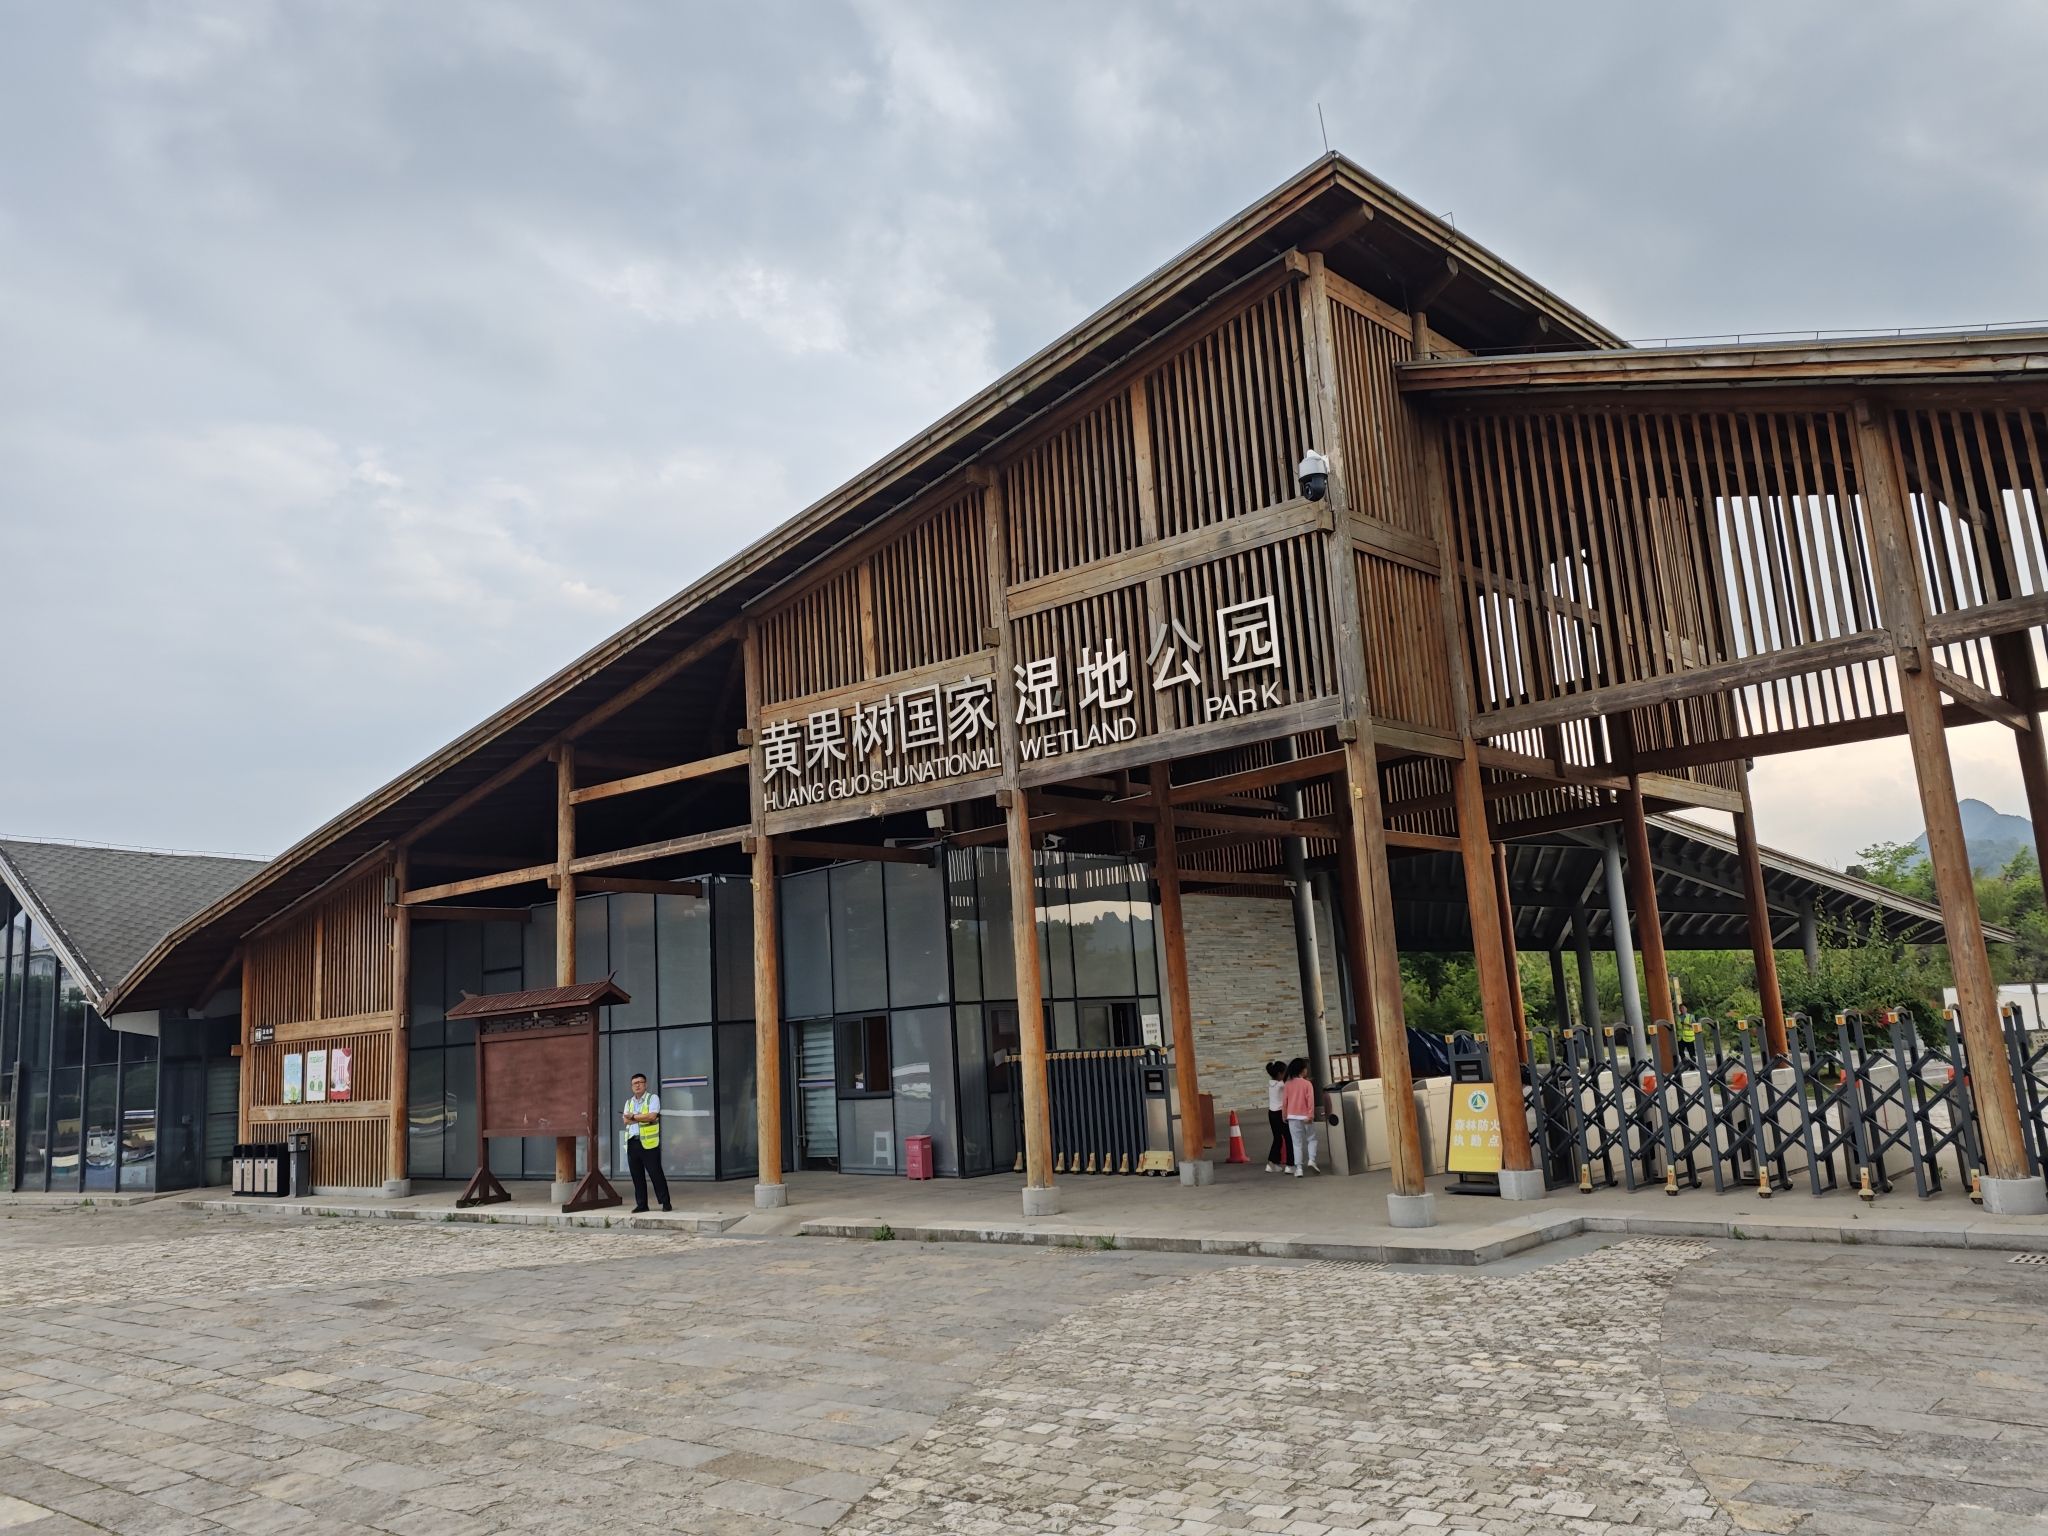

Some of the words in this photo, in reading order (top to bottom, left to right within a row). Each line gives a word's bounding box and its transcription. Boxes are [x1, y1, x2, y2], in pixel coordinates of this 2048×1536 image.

[763, 782, 824, 812] HUANG
[1020, 717, 1137, 761] WETLAND
[1206, 681, 1282, 722] PARK
